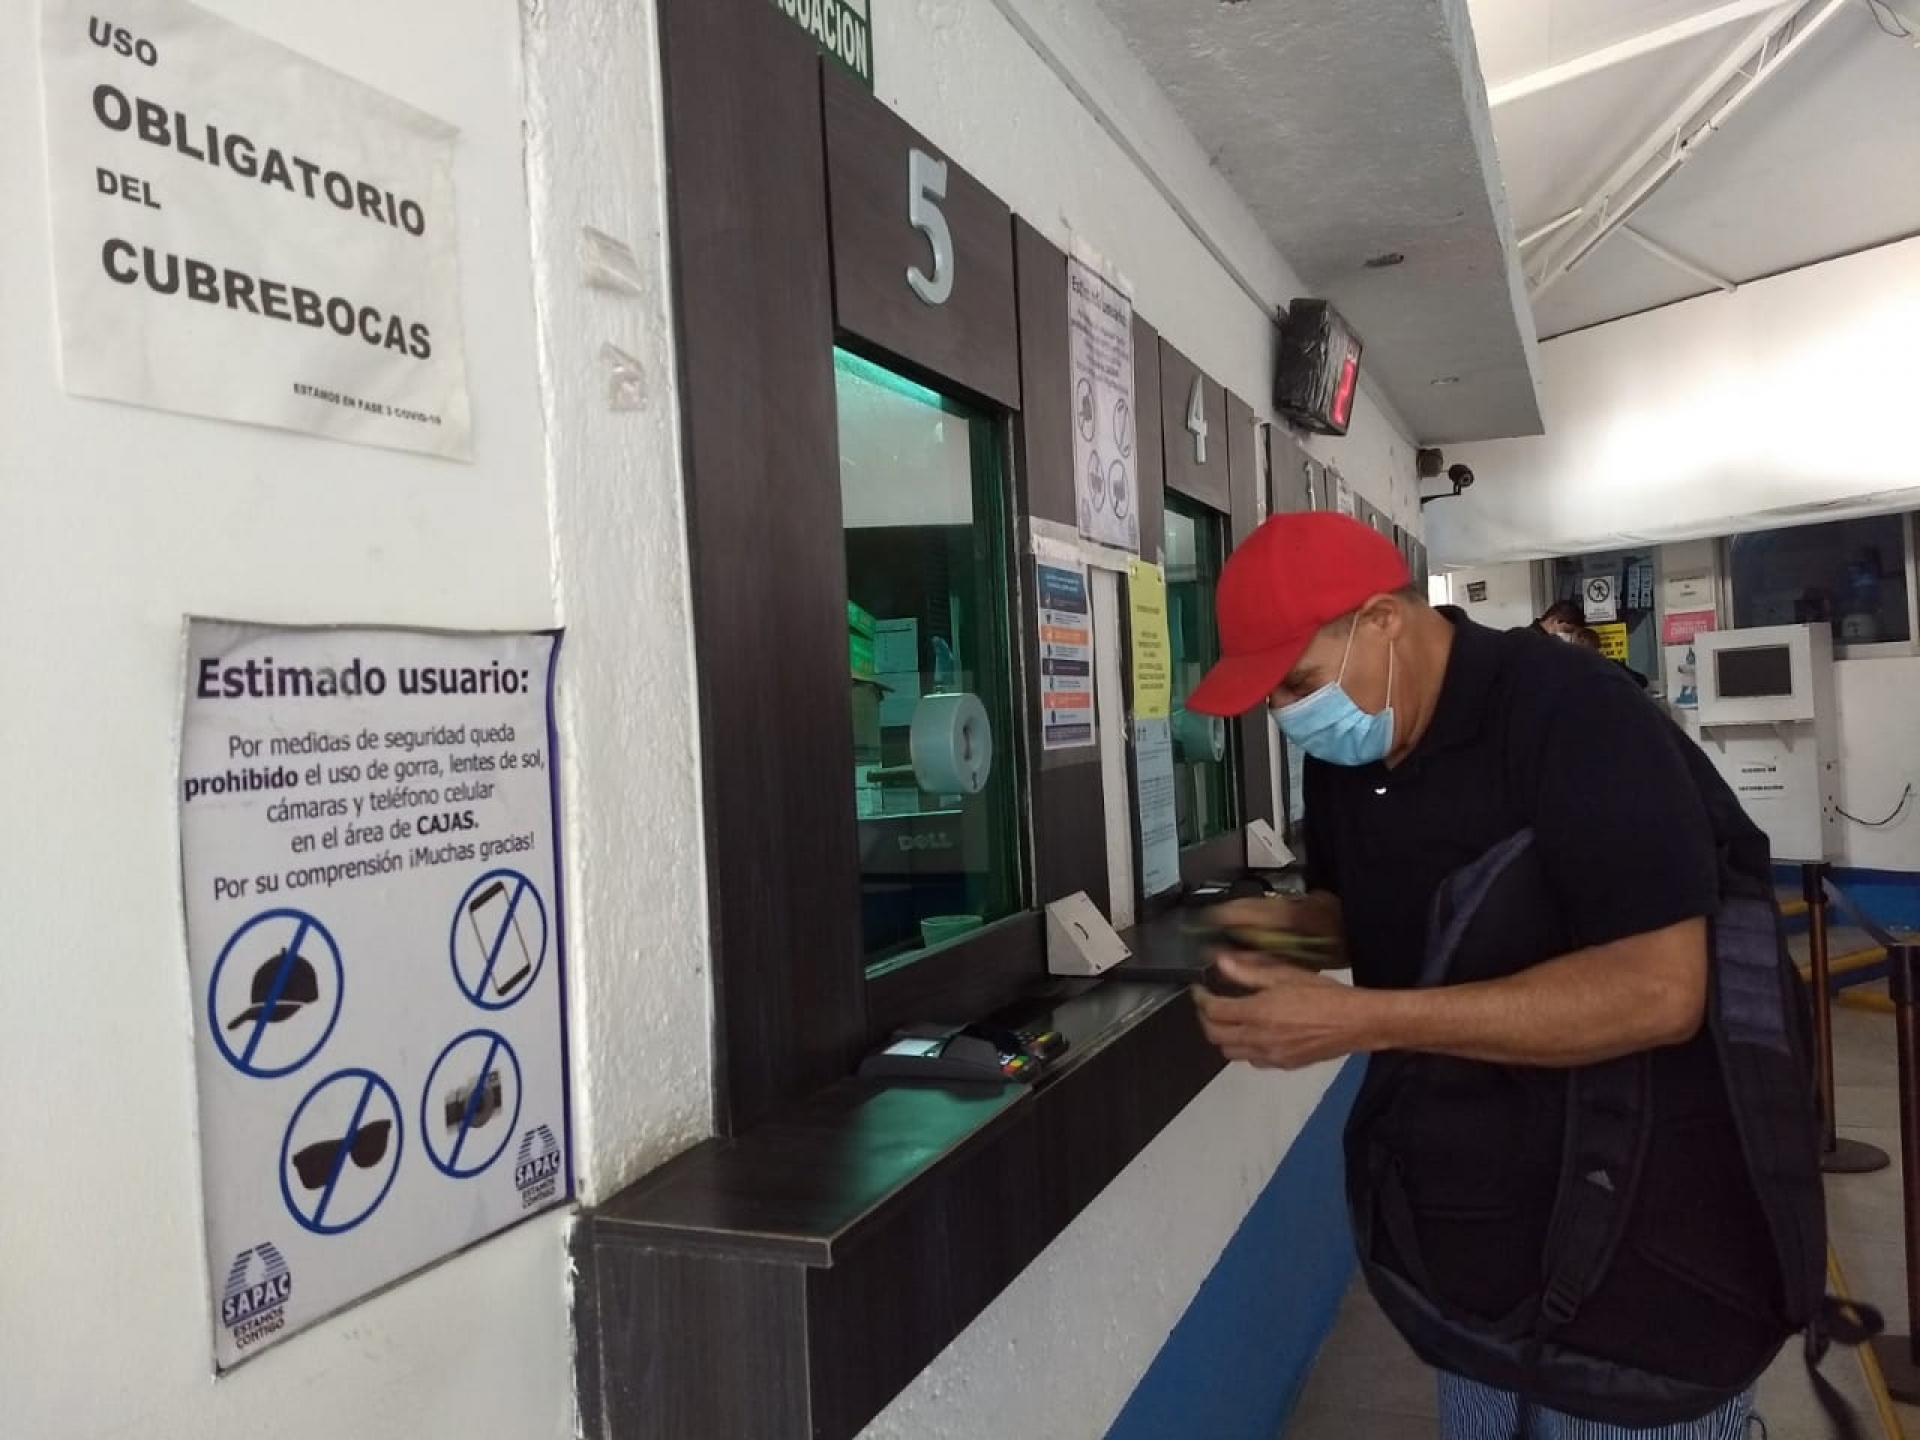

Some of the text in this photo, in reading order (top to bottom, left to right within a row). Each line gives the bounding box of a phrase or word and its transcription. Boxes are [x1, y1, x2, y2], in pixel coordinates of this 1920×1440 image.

[89, 16, 157, 66] USO
[92, 83, 426, 237] OBLIGATORIO
[96, 168, 161, 210] DEL
[906, 147, 955, 305] 5
[101, 237, 431, 360] CUBREBOCAS
[294, 383, 340, 405] ESTAMOS
[342, 395, 356, 407] EN
[358, 399, 383, 415] FASE
[394, 407, 442, 426] COVID-19
[1187, 371, 1208, 463] 4
[197, 656, 528, 699] Estimado usuario:
[229, 723, 515, 759] Por medidas de seguridad queda
[184, 749, 545, 803] prohibido el uso de gorra, lentes de sol,
[266, 781, 495, 823] cámaras y teléfono celular
[291, 810, 479, 852] en el área de CAJAS.
[214, 876, 249, 901] Por
[255, 874, 279, 895] su
[286, 850, 402, 888] comprensión
[480, 830, 534, 862] gracias!
[516, 1150, 560, 1187] SAPAC
[223, 1272, 289, 1323] SAPAC
[234, 1305, 283, 1338] ESTAMOS
[236, 1318, 285, 1350] CONTIGO
